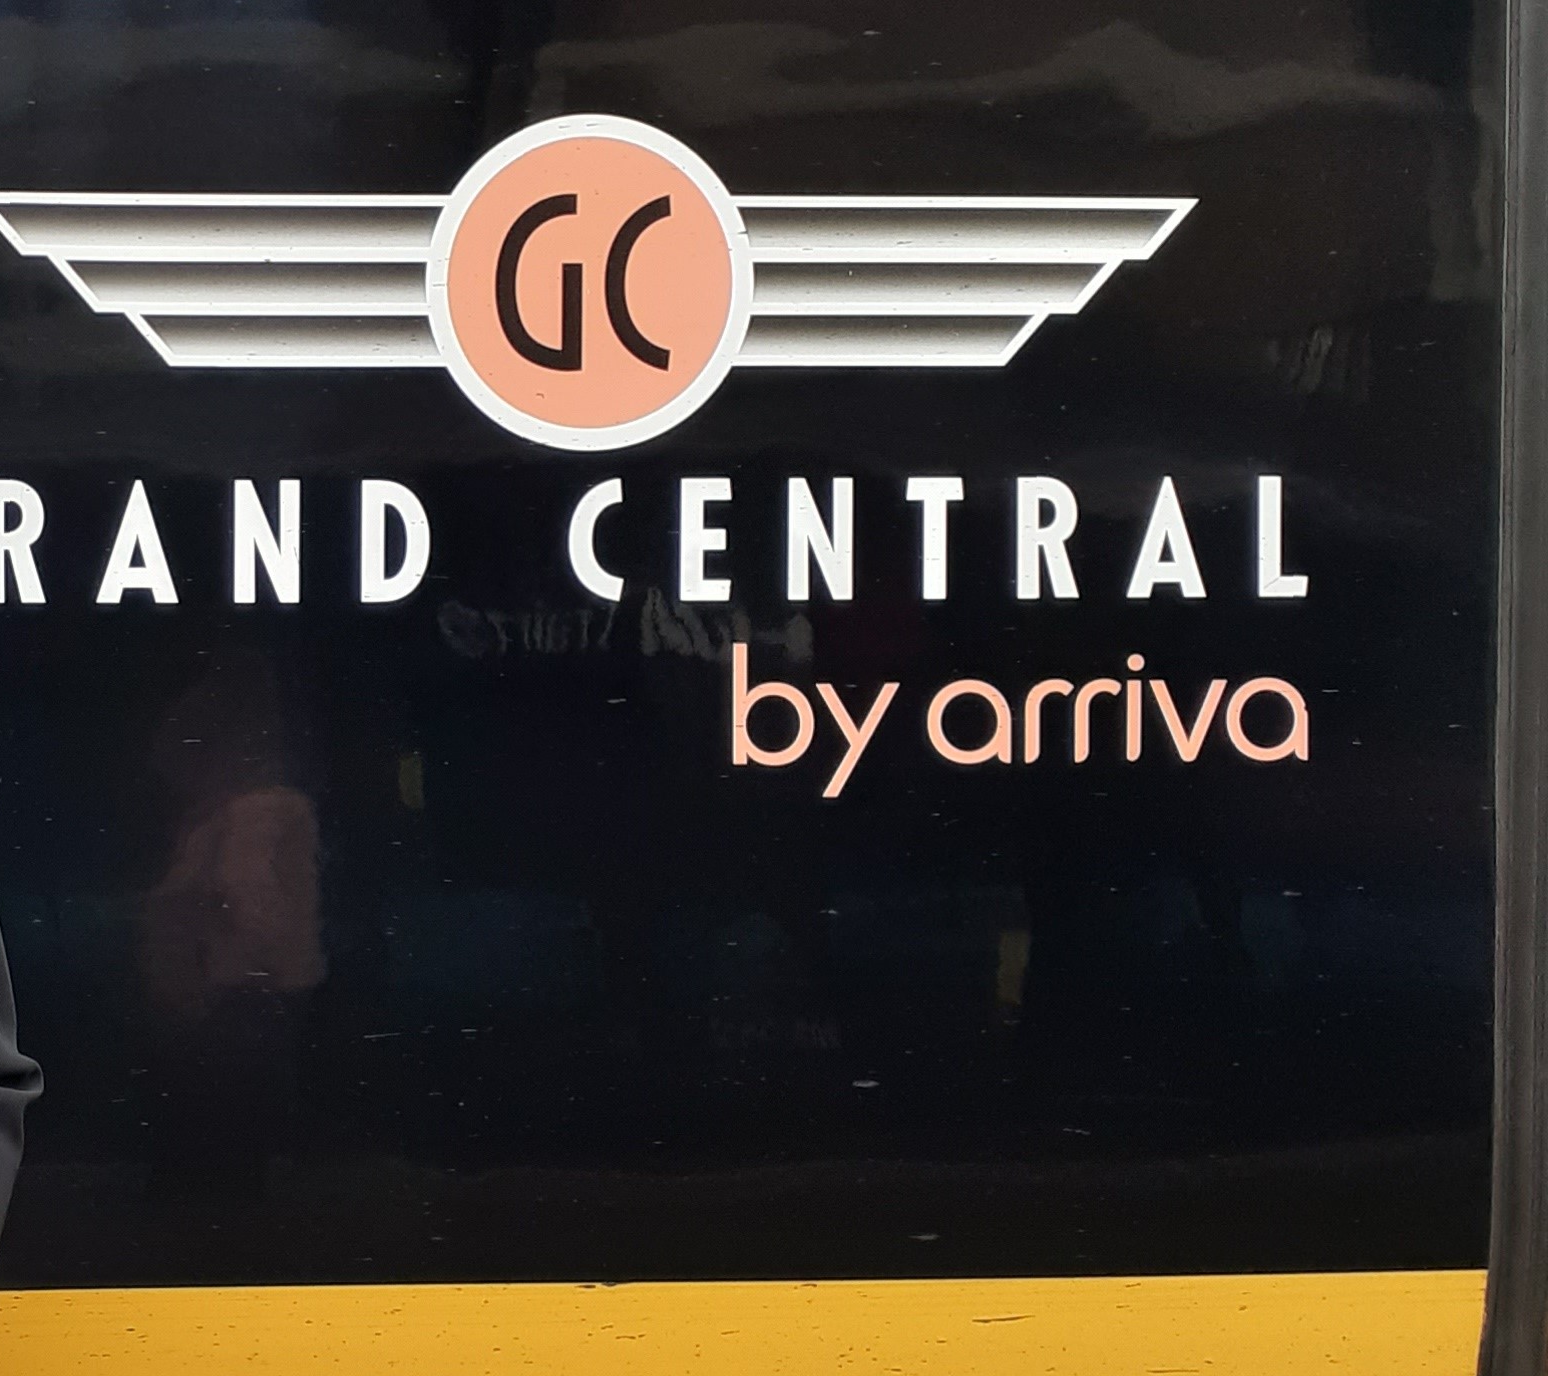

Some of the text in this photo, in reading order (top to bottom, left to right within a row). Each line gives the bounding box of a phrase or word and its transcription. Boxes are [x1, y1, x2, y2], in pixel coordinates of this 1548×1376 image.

[495, 193, 672, 372] GC
[568, 474, 1309, 602] CENTRAL
[732, 642, 1309, 798] by arriva
